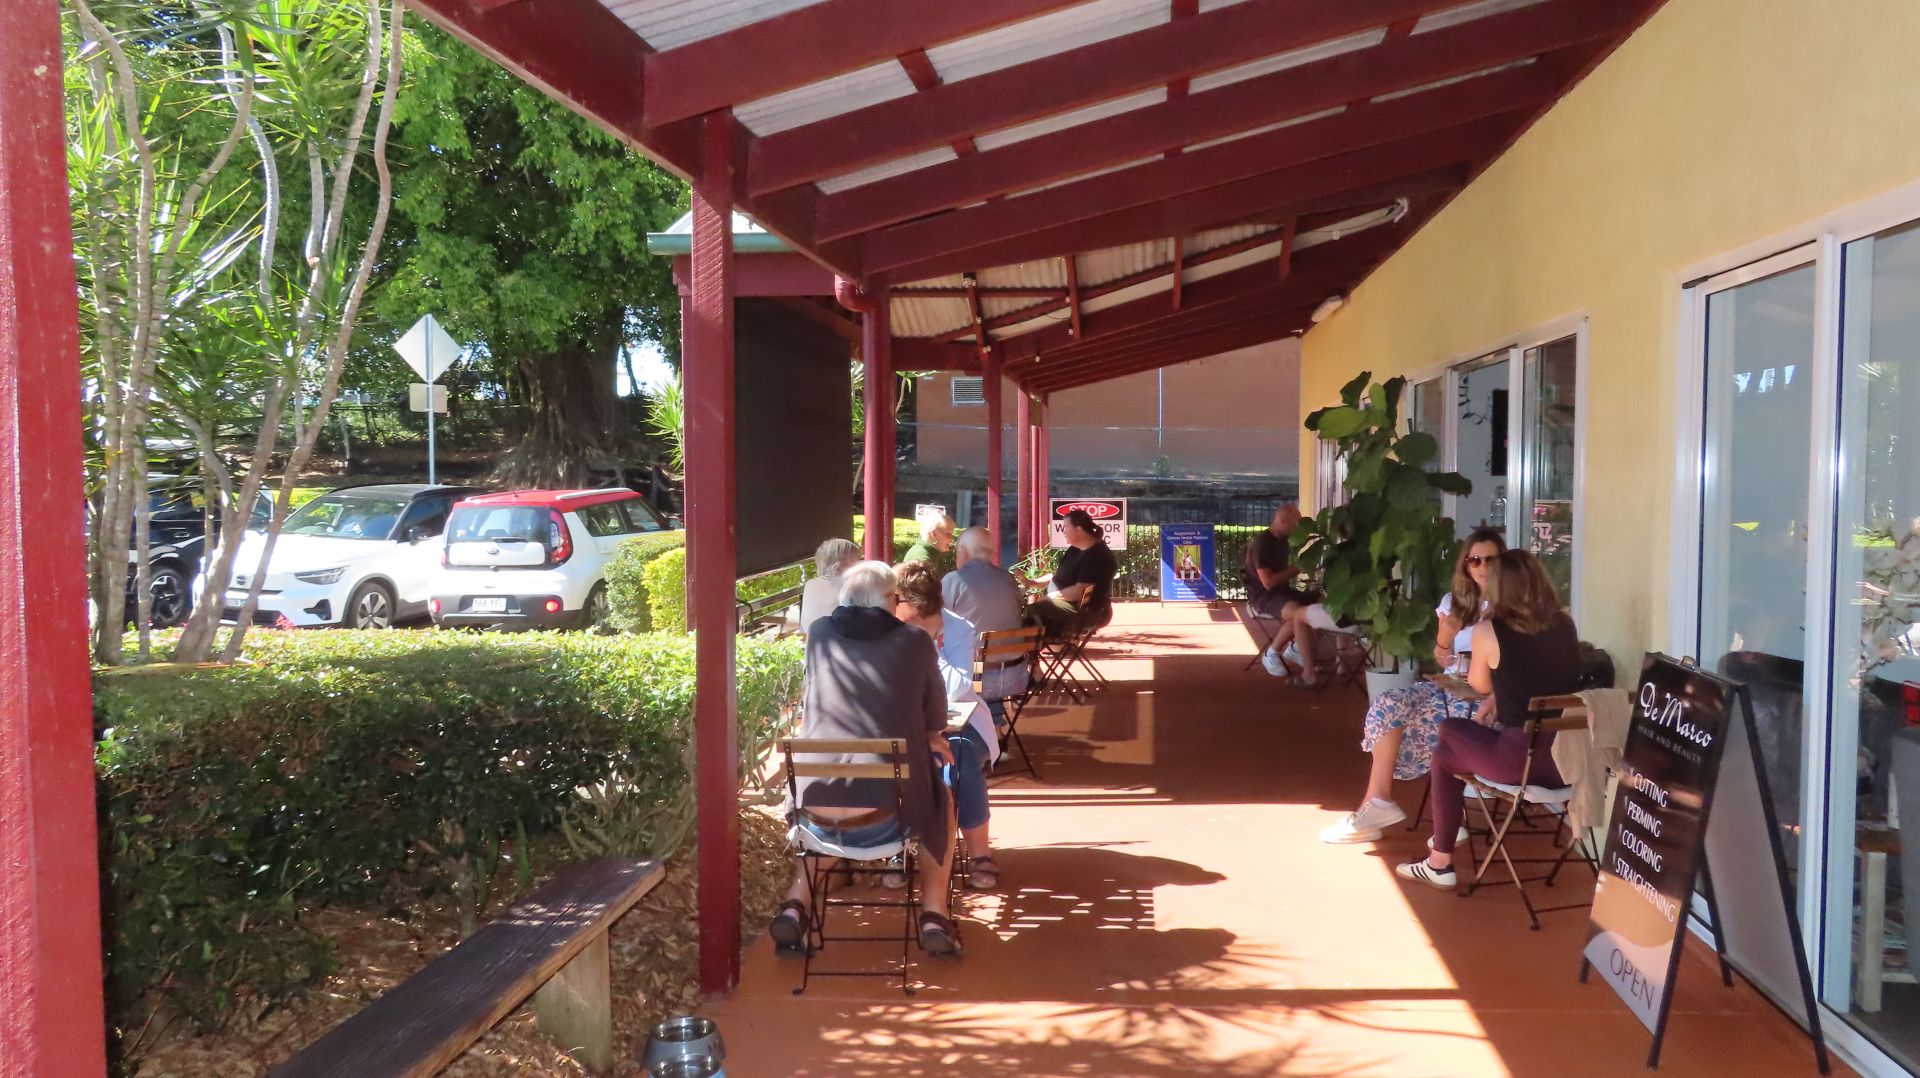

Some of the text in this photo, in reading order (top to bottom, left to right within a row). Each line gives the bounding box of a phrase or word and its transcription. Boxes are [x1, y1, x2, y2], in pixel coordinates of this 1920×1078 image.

[1640, 682, 1712, 747] De Marco
[1638, 724, 1702, 766] HAIR AND BEAUTY
[1633, 772, 1669, 808] CUTTING
[1627, 800, 1662, 838] PERMING
[1622, 829, 1663, 873] COLORING
[1615, 857, 1676, 922] STRAIGHTENING
